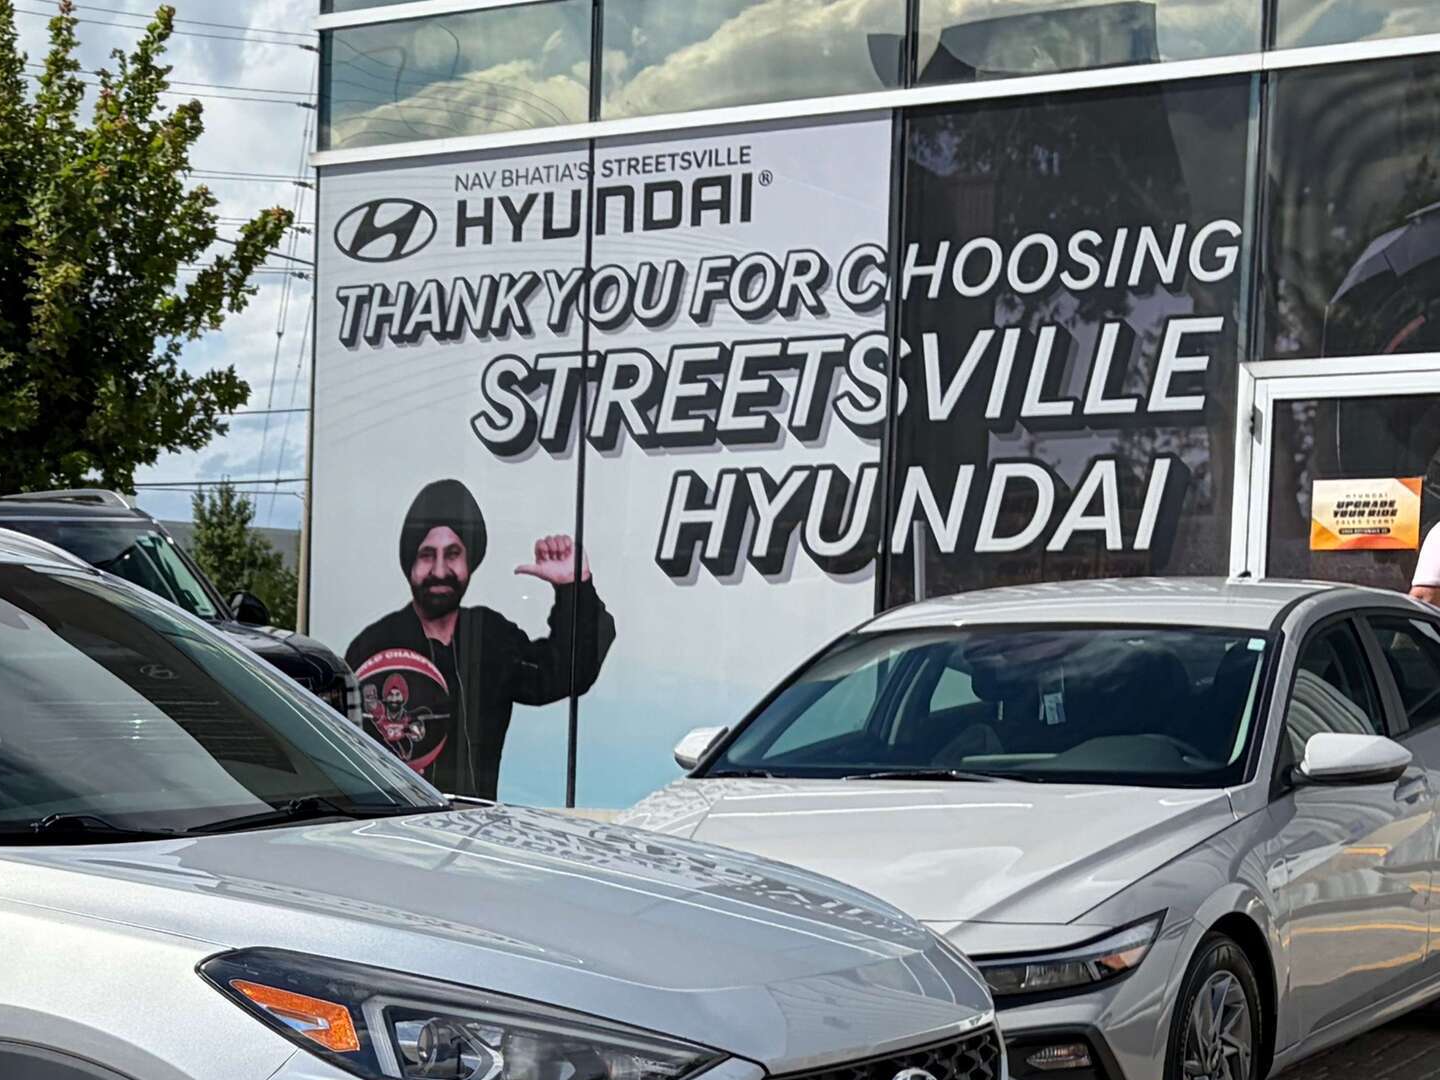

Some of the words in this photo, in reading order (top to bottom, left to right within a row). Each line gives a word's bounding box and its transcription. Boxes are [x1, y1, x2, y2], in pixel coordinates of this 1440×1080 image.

[455, 170, 496, 193] NAV
[502, 161, 591, 187] BHATIA'S
[601, 145, 752, 178] STREETSVILLE
[336, 270, 540, 349] THANK
[544, 260, 687, 334] YOU
[689, 248, 830, 326] FOR
[836, 219, 1243, 312] CHOOSING
[470, 315, 1226, 459] STREETSVILLE
[654, 453, 1182, 579] HYUNDAI
[1333, 508, 1365, 518] YOUR
[1367, 508, 1398, 517] RIDE
[1336, 499, 1397, 509] UPGRADE
